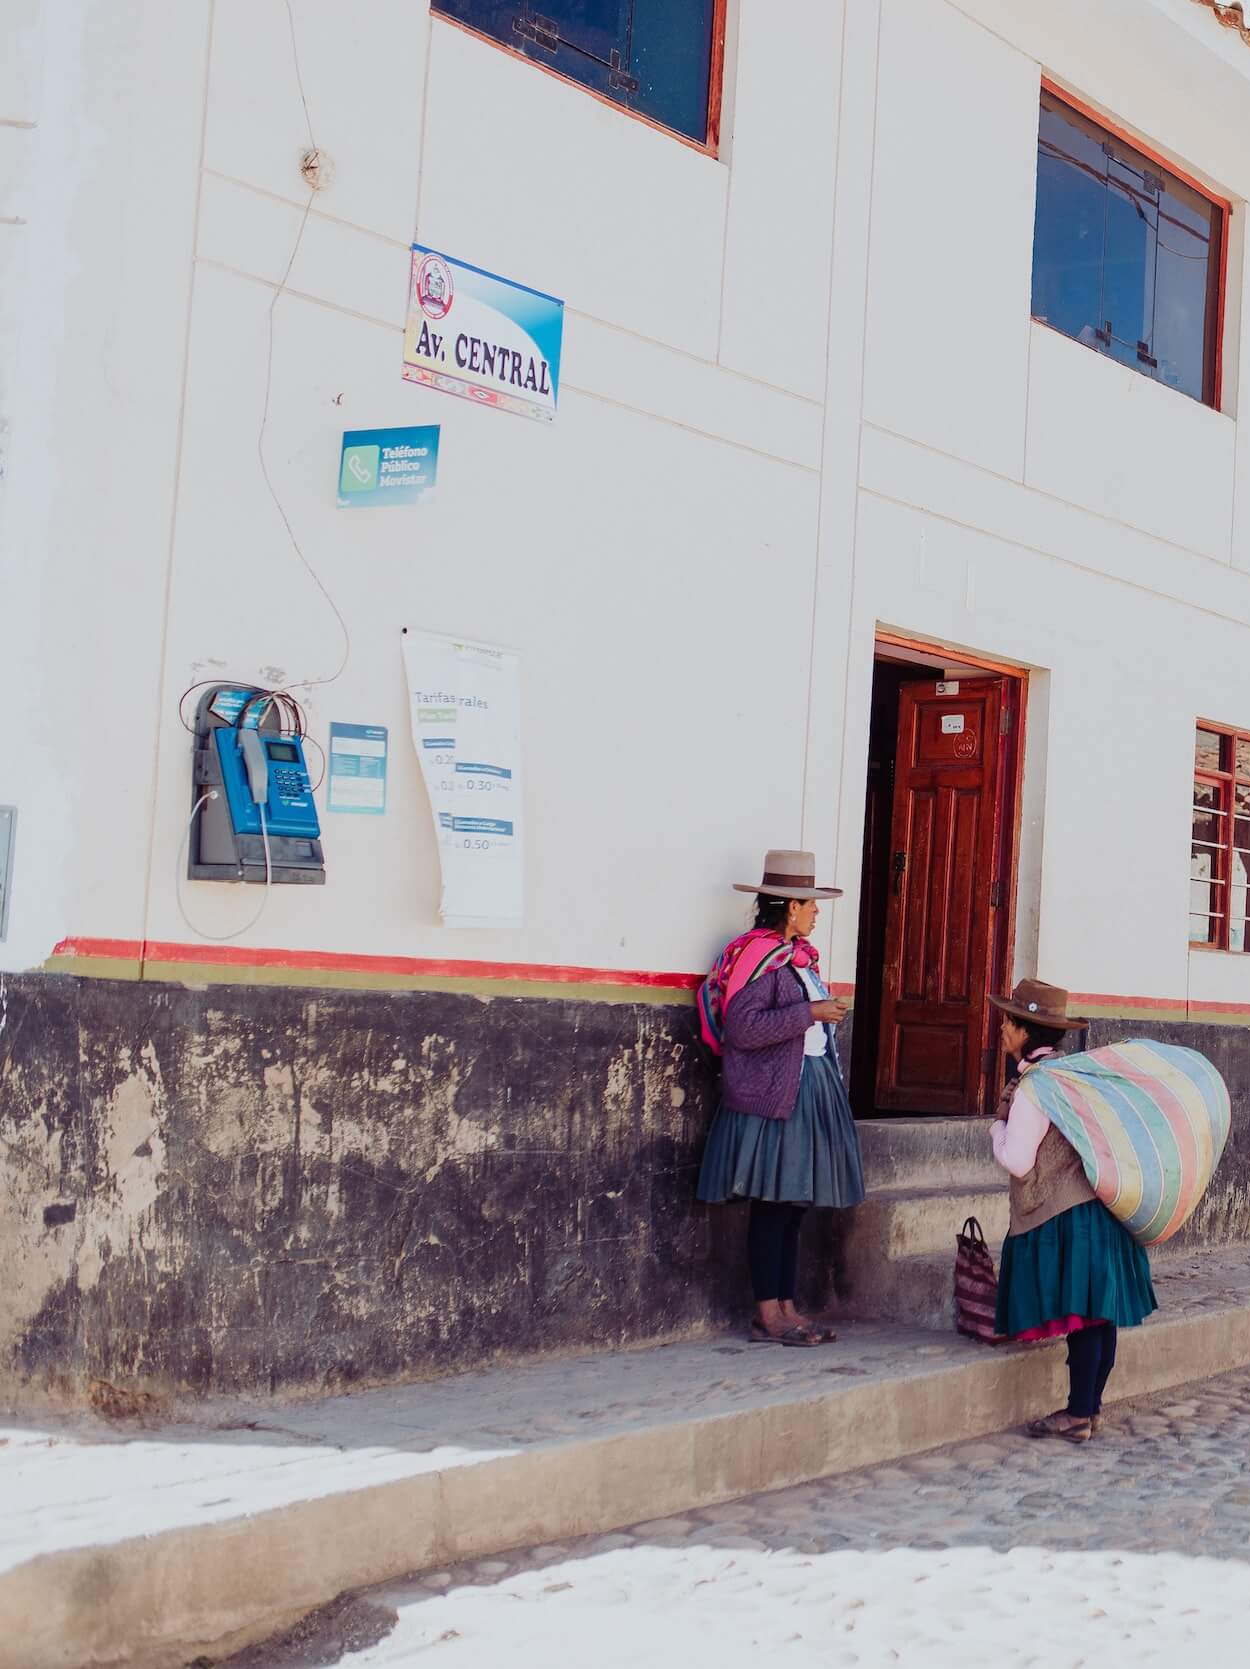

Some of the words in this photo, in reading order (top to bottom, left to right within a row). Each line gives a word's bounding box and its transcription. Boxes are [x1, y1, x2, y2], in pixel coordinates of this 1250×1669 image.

[415, 319, 446, 362] Av.
[455, 332, 551, 396] CENTRAL
[382, 445, 428, 459] Teléfono
[380, 460, 420, 473] Público
[415, 691, 456, 704] Tarifas
[463, 839, 490, 850] 0.50
